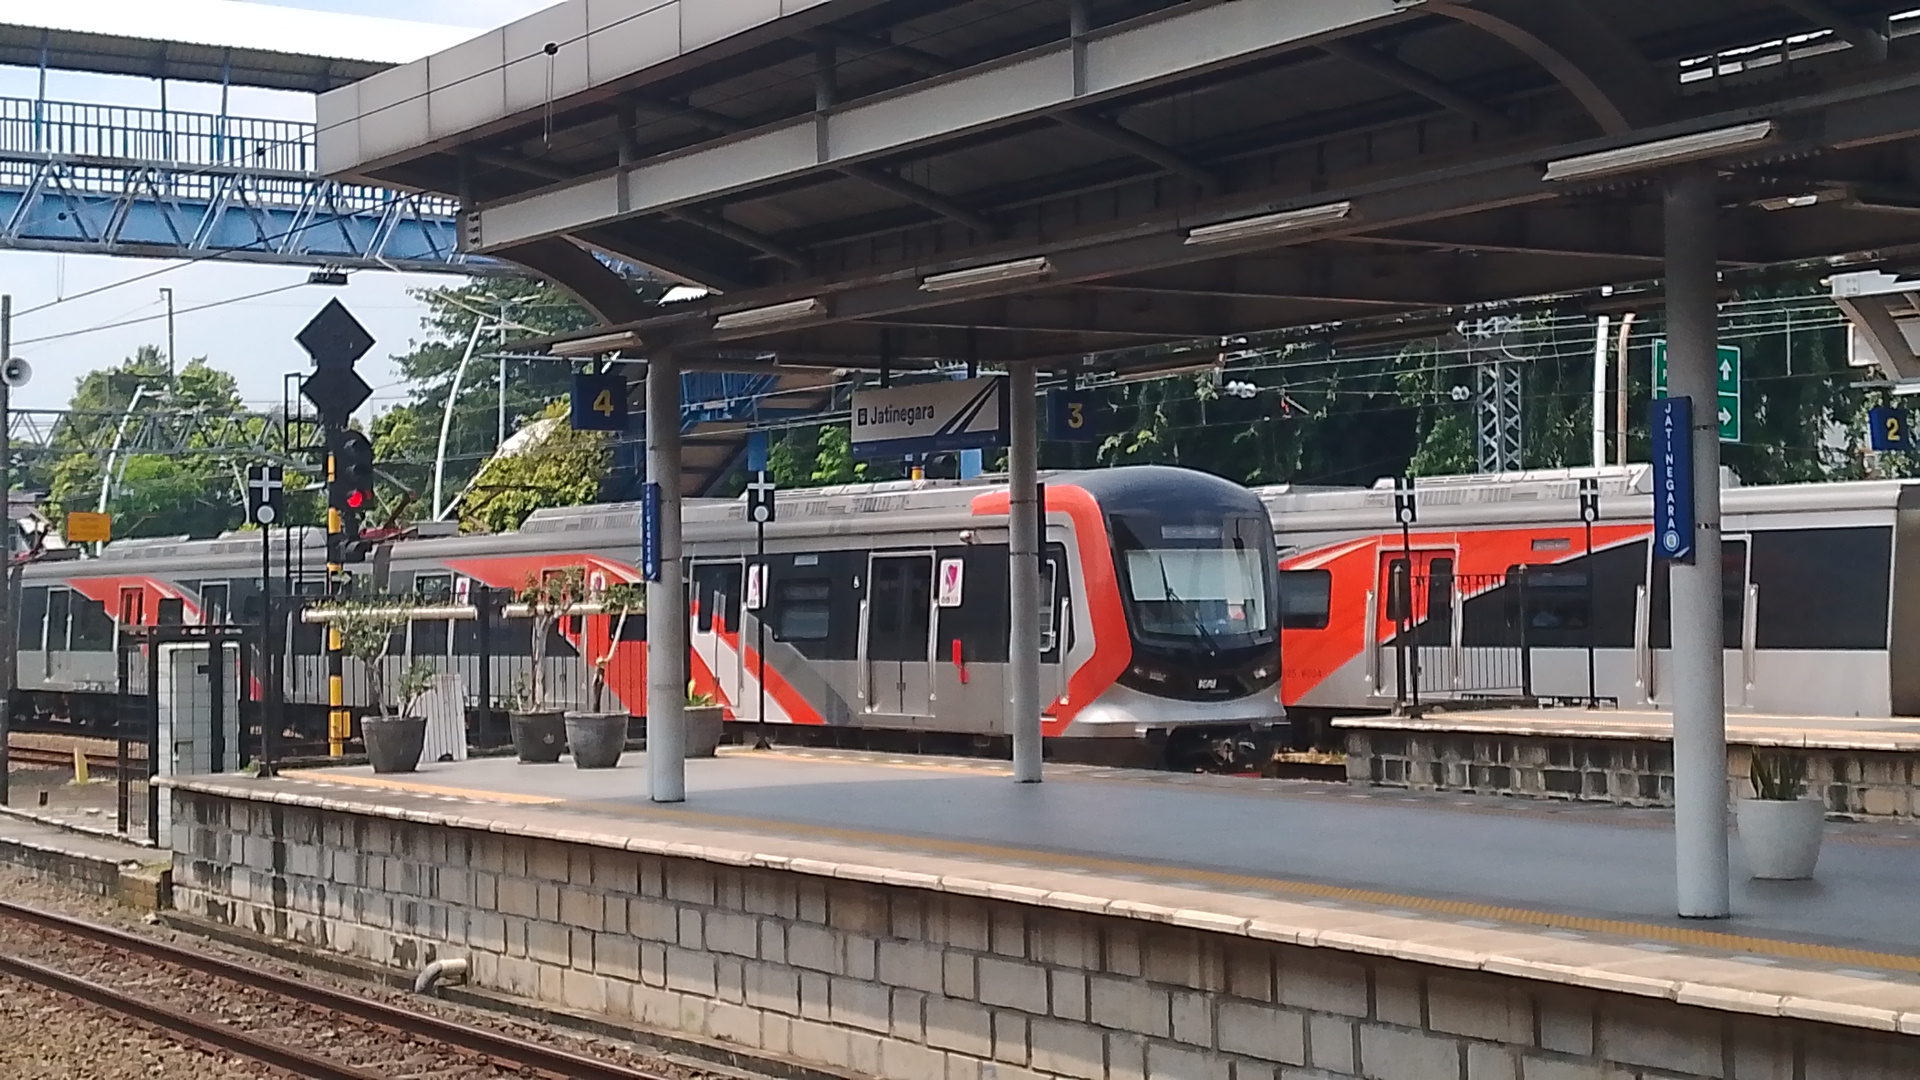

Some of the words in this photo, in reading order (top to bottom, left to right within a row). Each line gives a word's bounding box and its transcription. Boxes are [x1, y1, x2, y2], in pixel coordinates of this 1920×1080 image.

[593, 389, 615, 417] 4
[870, 403, 935, 426] Jatinegara
[1067, 402, 1084, 429] 3
[1886, 417, 1900, 441] 2
[1664, 402, 1676, 529] JATINEGARA
